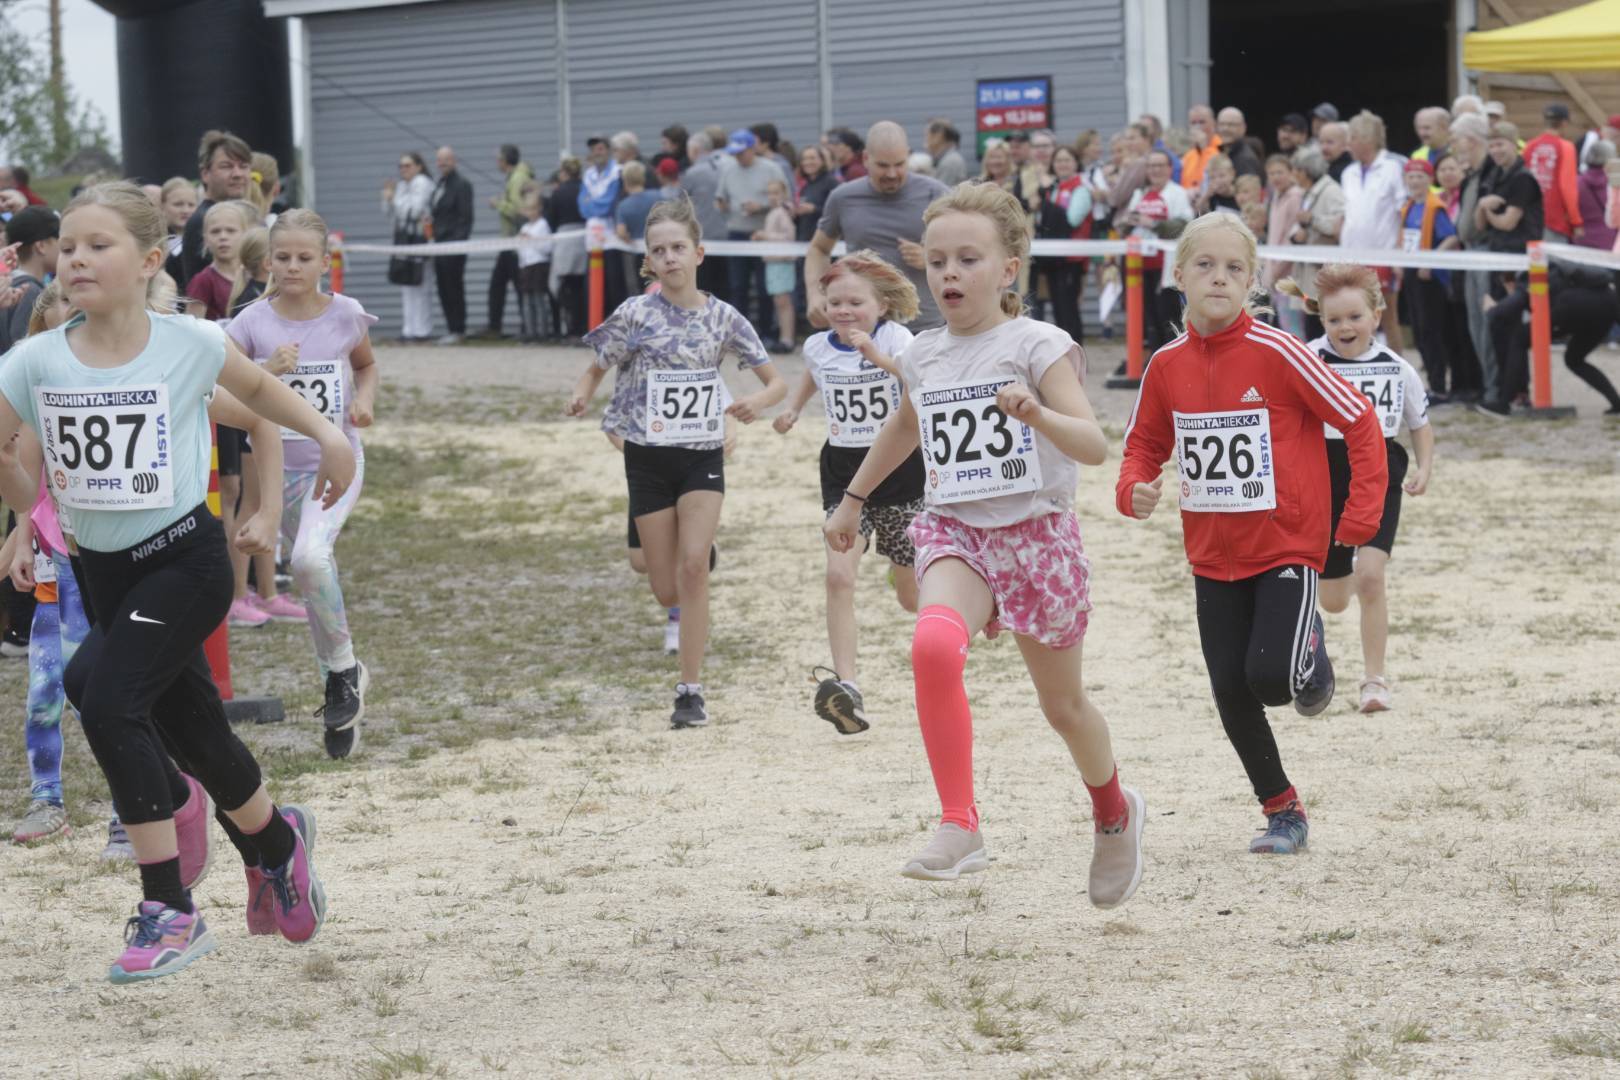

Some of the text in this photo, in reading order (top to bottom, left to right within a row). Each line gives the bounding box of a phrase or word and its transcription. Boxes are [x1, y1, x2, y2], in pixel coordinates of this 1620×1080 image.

[1003, 88, 1021, 101] km
[1027, 110, 1046, 123] km
[43, 390, 158, 407] LOUHINTAHIEKKA
[662, 384, 714, 419] 527
[833, 386, 889, 423] 555
[58, 414, 147, 471] 587
[931, 404, 1014, 467] 523
[1184, 433, 1255, 481] 526
[87, 478, 123, 490] PPR
[956, 467, 993, 482] PPR
[1206, 485, 1234, 496] PPR
[131, 516, 197, 562] NIKE PRO
